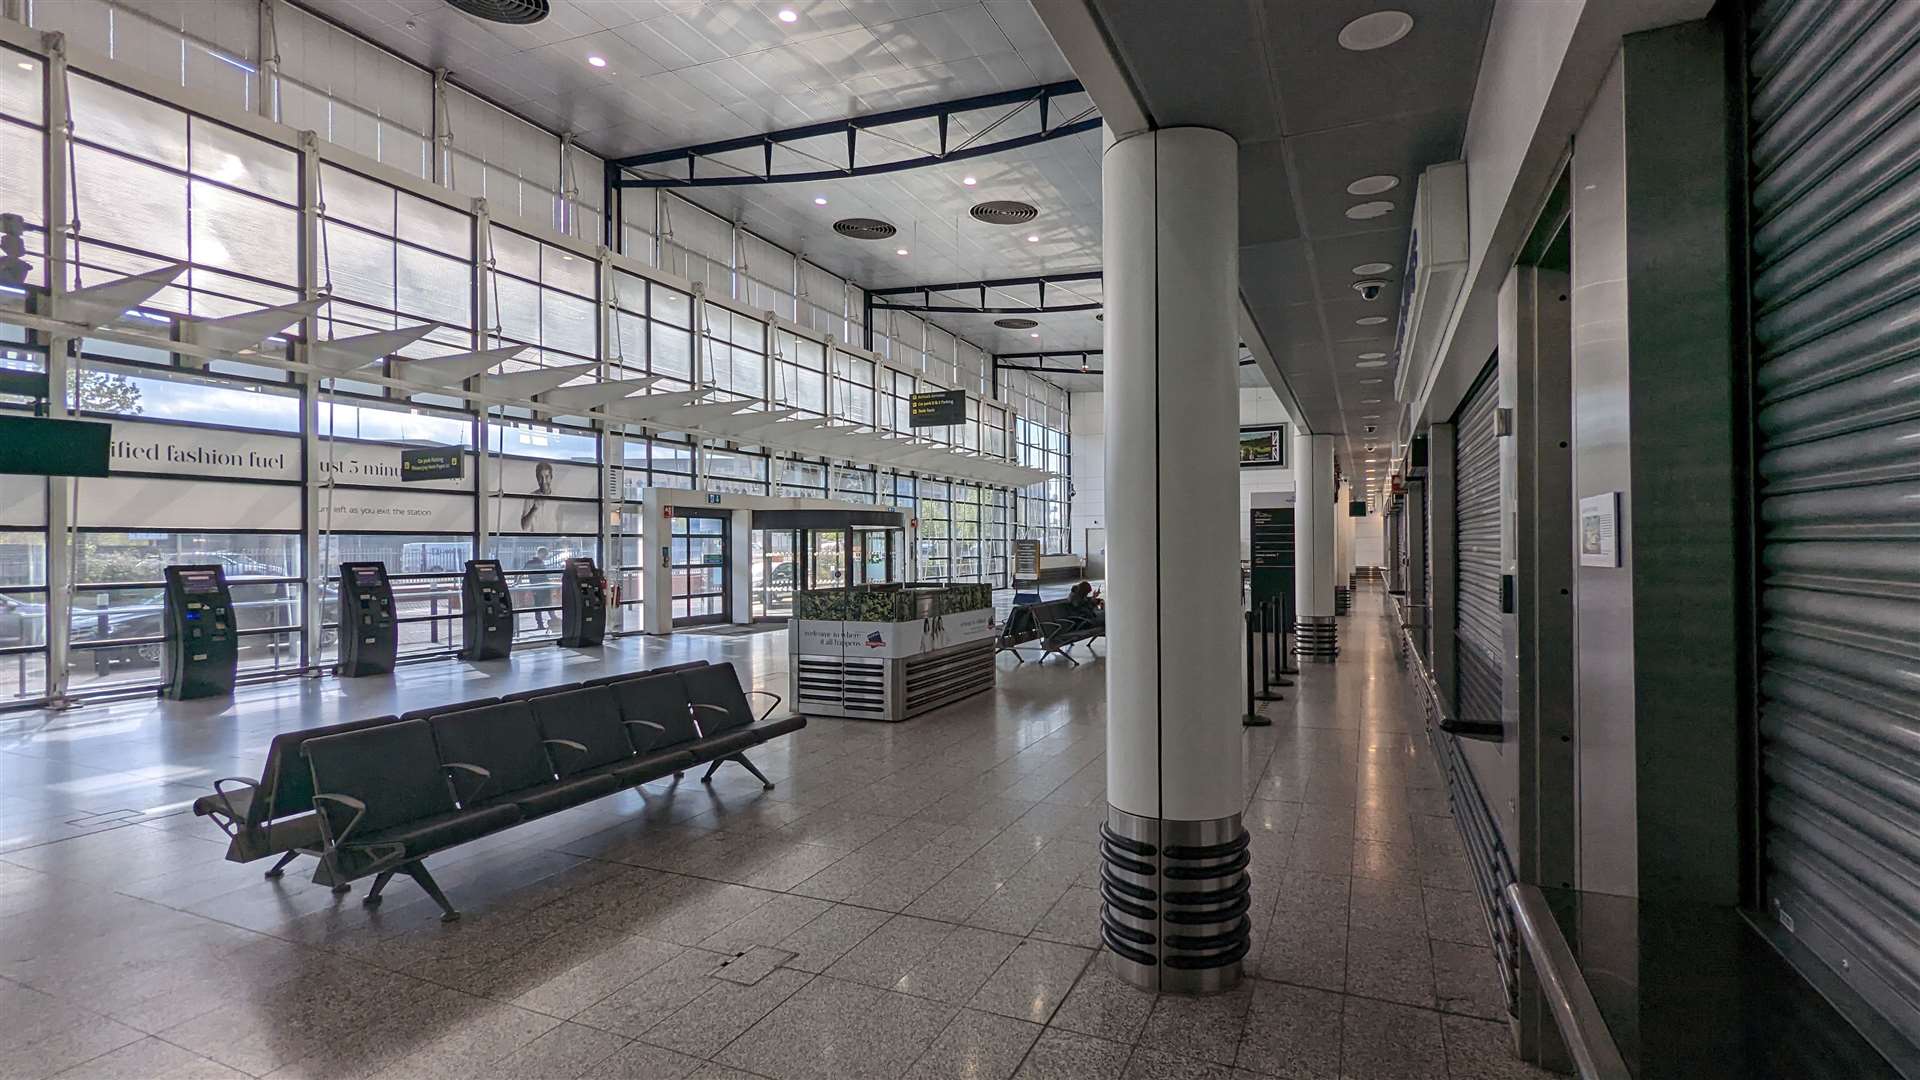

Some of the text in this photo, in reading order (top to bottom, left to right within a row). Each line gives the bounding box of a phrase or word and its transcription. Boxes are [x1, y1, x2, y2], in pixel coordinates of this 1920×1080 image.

[111, 440, 284, 470] ified fashion fuel
[319, 461, 343, 473] ust
[349, 460, 359, 474] 5
[360, 507, 376, 516] you
[376, 506, 391, 515] exit
[392, 506, 405, 516] the
[407, 508, 432, 517] station
